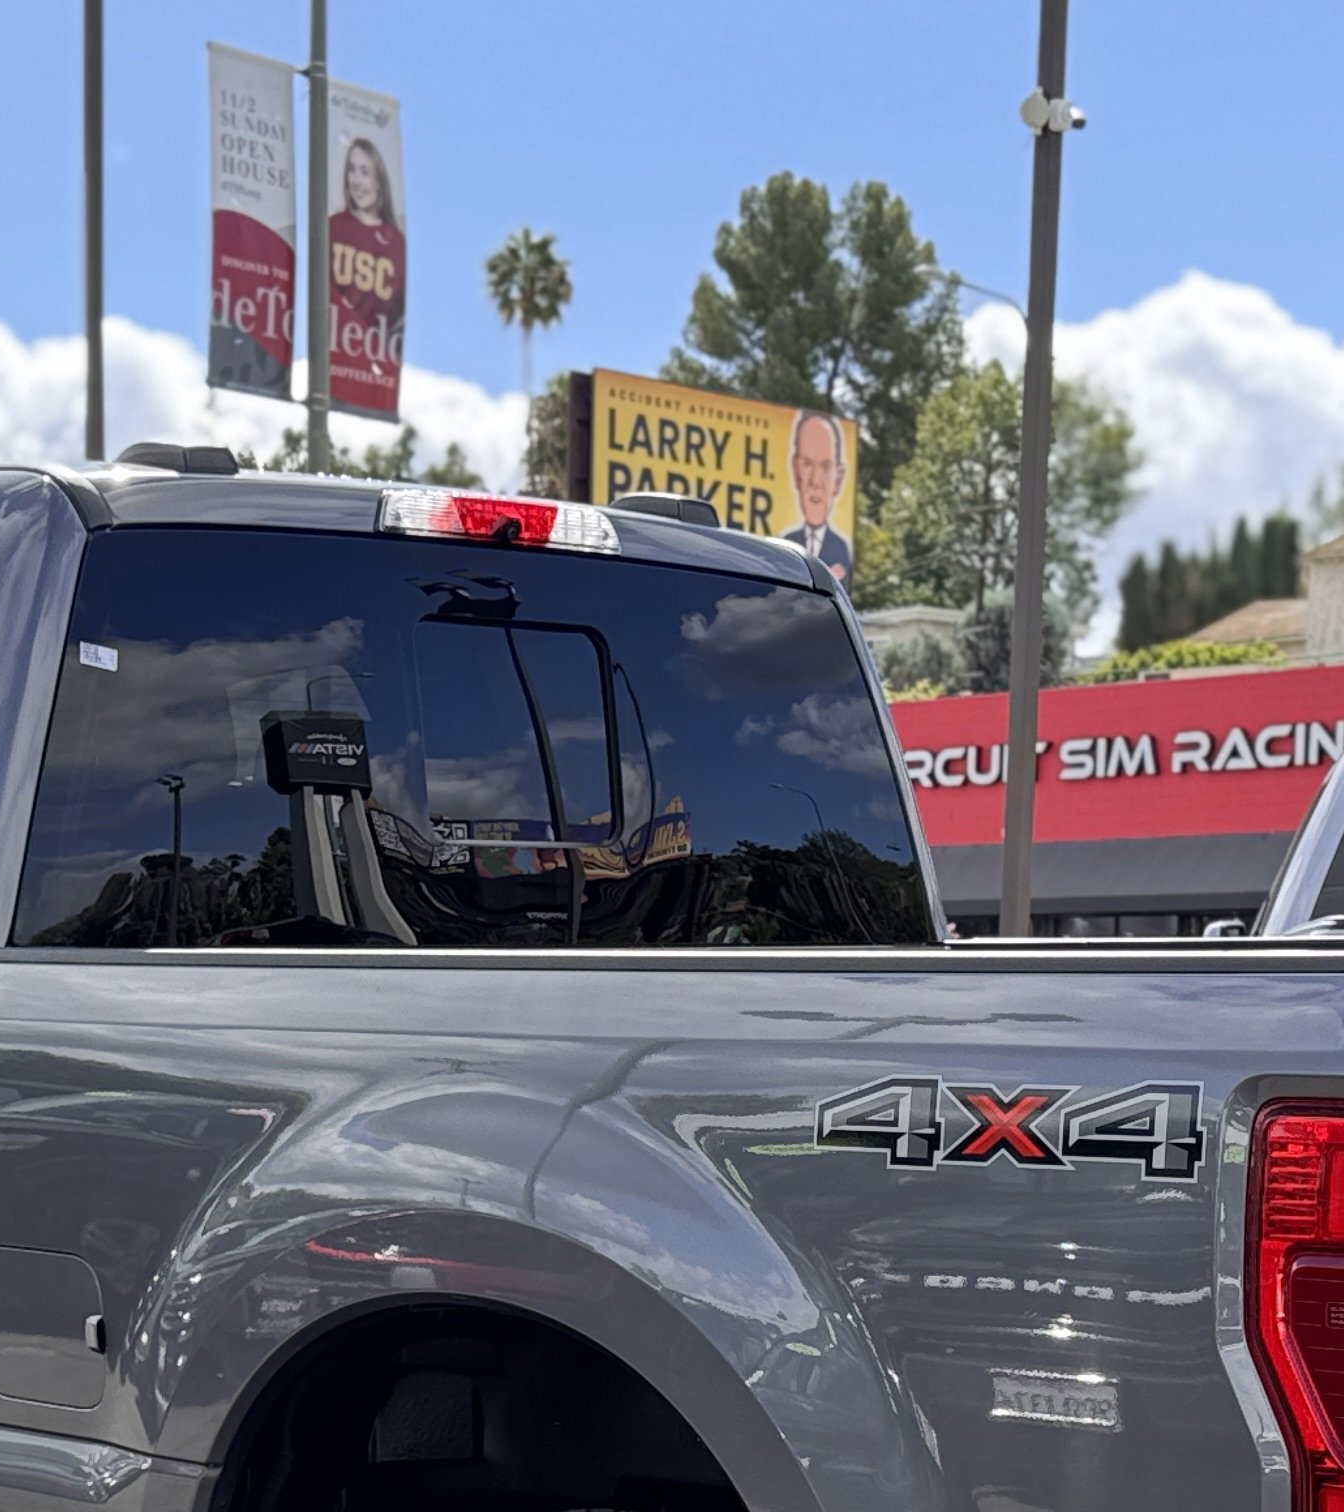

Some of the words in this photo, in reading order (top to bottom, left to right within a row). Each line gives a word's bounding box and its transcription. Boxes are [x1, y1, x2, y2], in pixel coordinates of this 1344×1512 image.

[220, 88, 256, 114] 11/2
[219, 110, 288, 143] SUNDAY
[220, 133, 275, 163] OPEN
[221, 153, 290, 190] HOUSE
[333, 242, 394, 300] USC
[608, 387, 682, 412] ACCIDENT
[689, 404, 770, 430] ATTORNEYS
[607, 407, 732, 471] LARRY
[744, 433, 775, 481] H.
[607, 460, 774, 536] PARKER
[1058, 733, 1157, 781] SIM
